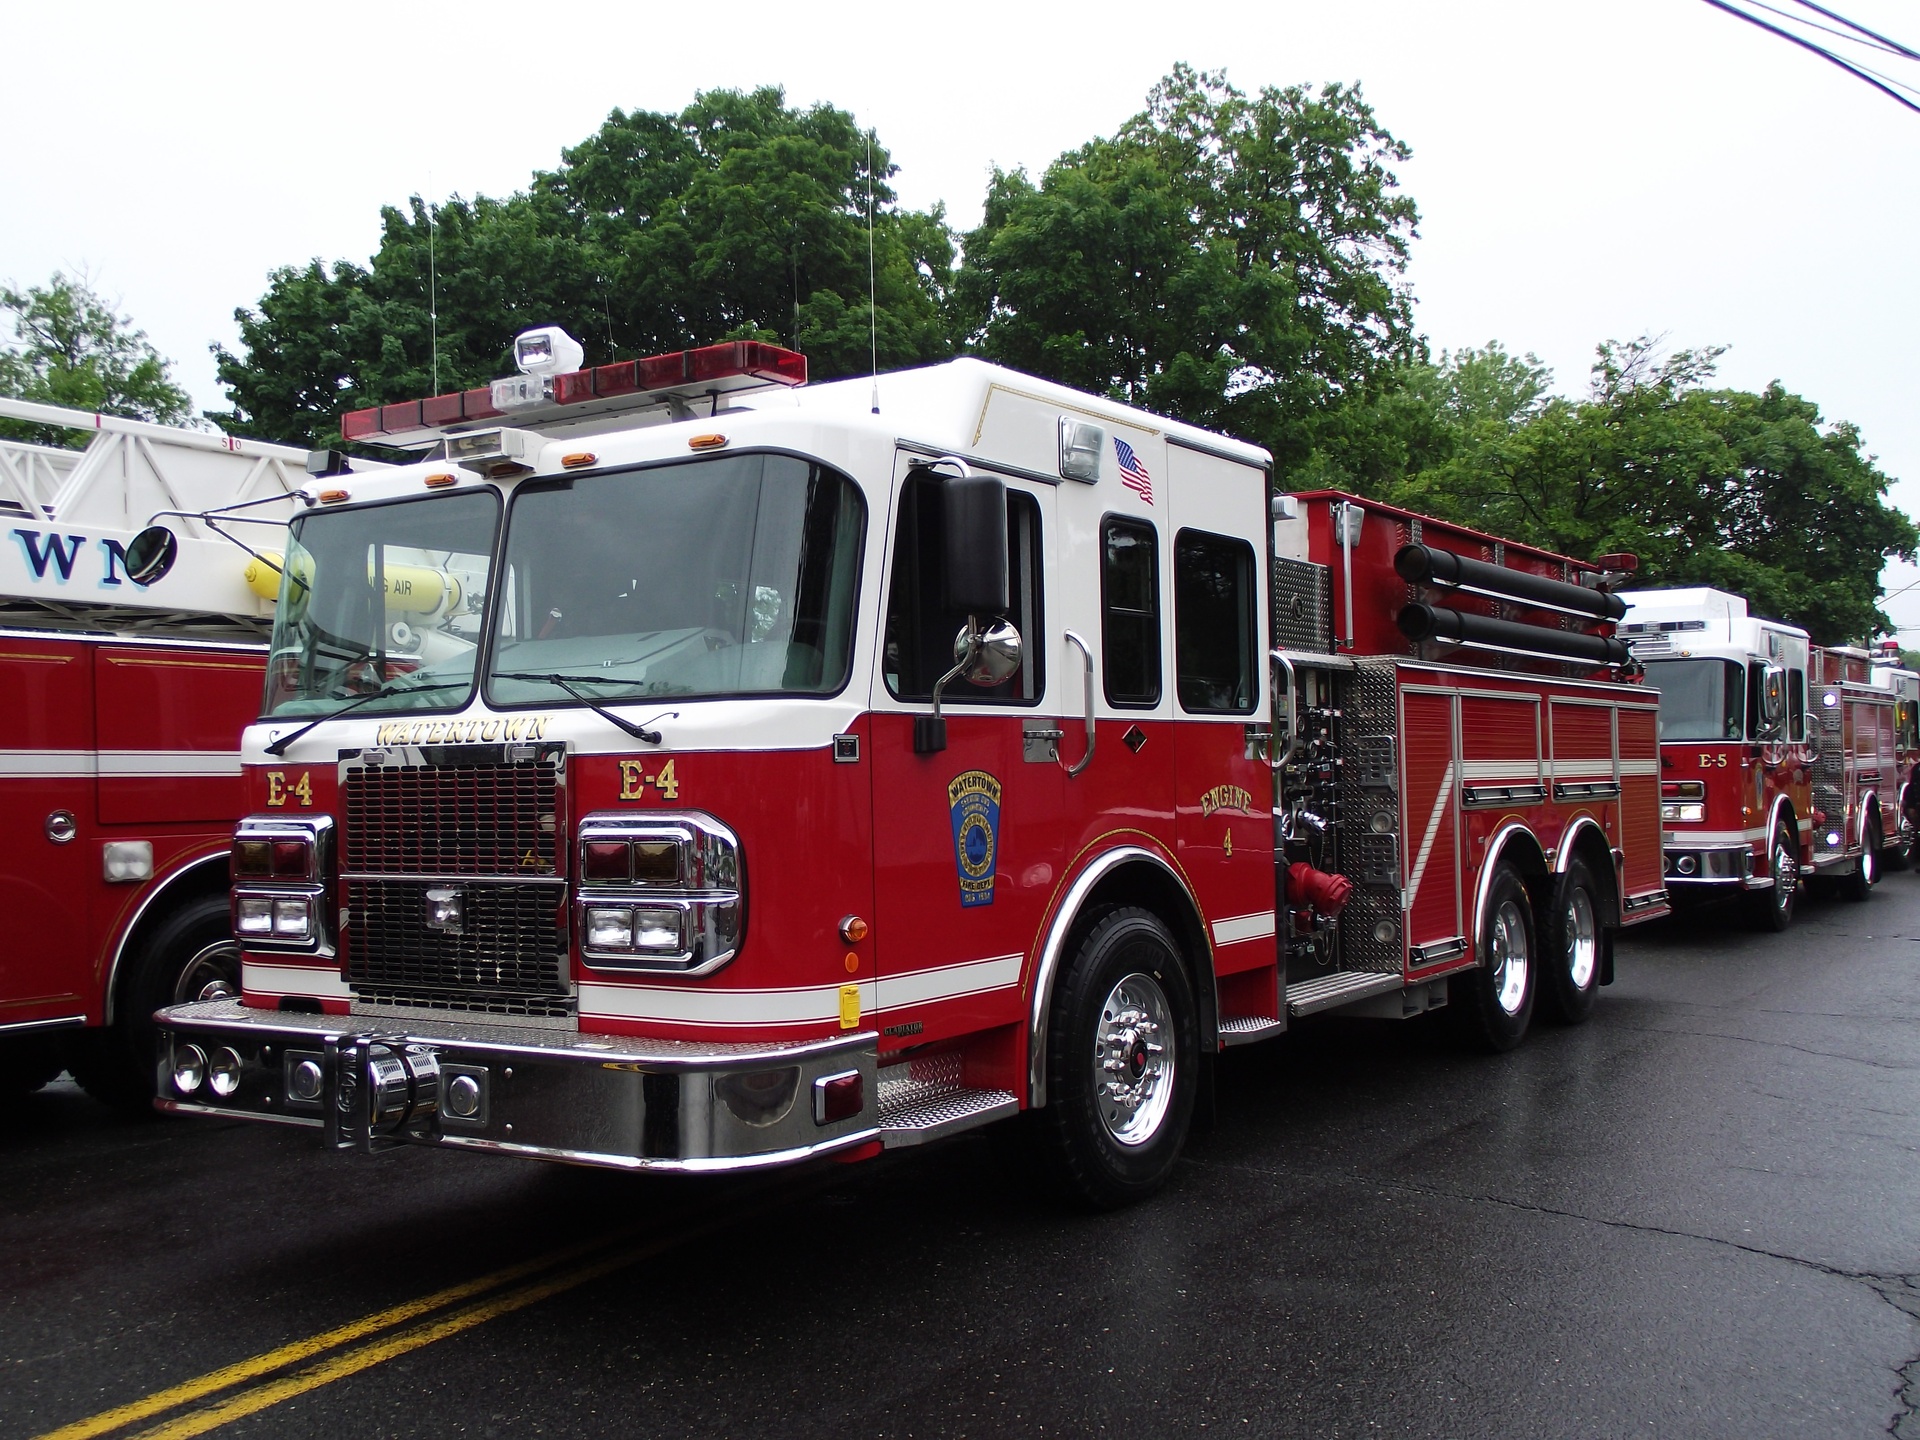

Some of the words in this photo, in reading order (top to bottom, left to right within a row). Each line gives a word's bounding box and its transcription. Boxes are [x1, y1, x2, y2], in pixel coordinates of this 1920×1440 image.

[393, 579, 412, 596] AIR
[376, 715, 552, 746] WATERTOWN
[1698, 753, 1728, 768] E-5
[266, 771, 313, 807] E-4
[618, 759, 679, 800] E-4
[951, 776, 999, 798] WATERTOWN
[1200, 785, 1252, 818] ENGINE
[1223, 827, 1233, 857] 4
[962, 880, 976, 890] FIRE
